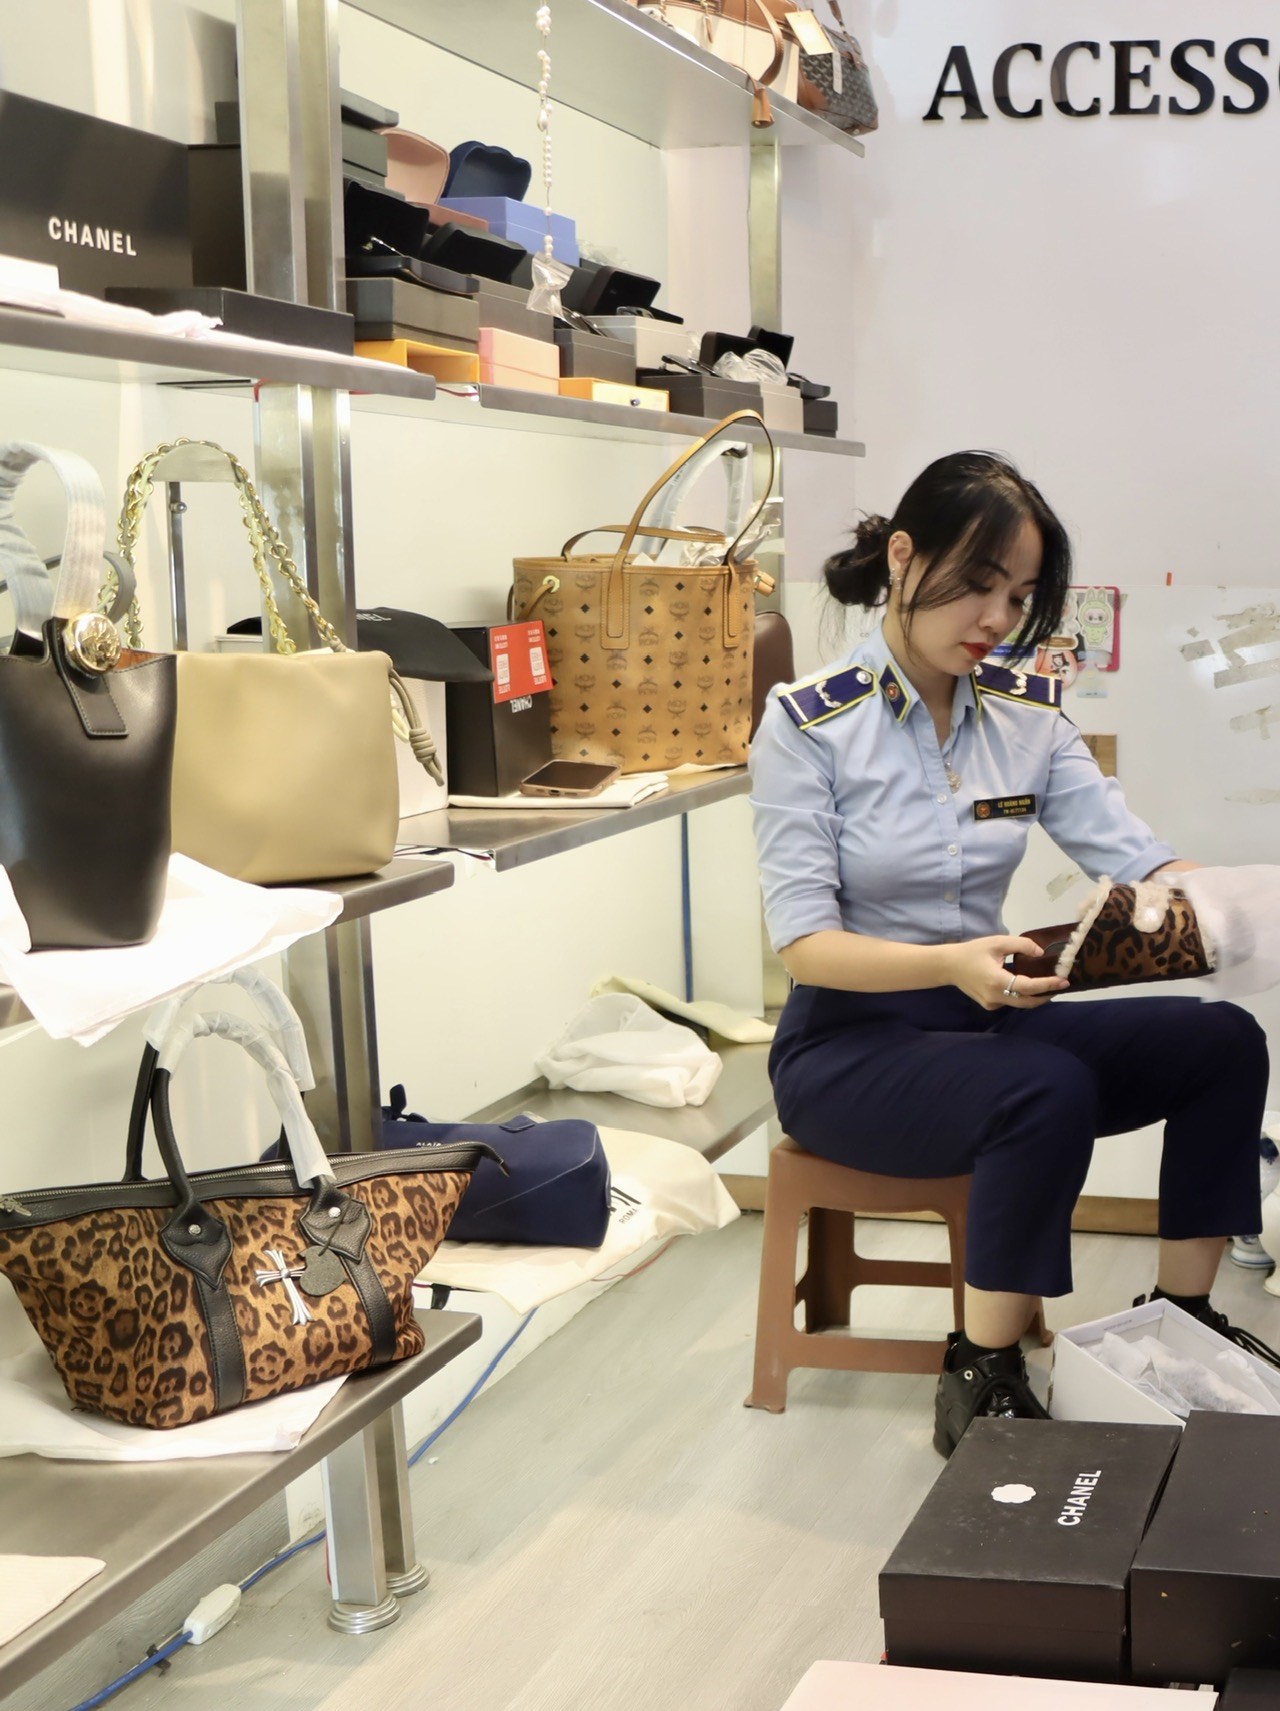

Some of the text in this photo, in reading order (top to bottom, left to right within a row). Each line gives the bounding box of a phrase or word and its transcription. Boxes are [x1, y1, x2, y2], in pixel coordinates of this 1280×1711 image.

[48, 215, 137, 256] CHANEL
[509, 695, 533, 714] CHANEL
[618, 1208, 638, 1225] ROMA
[1057, 1470, 1102, 1526] CHANEL
